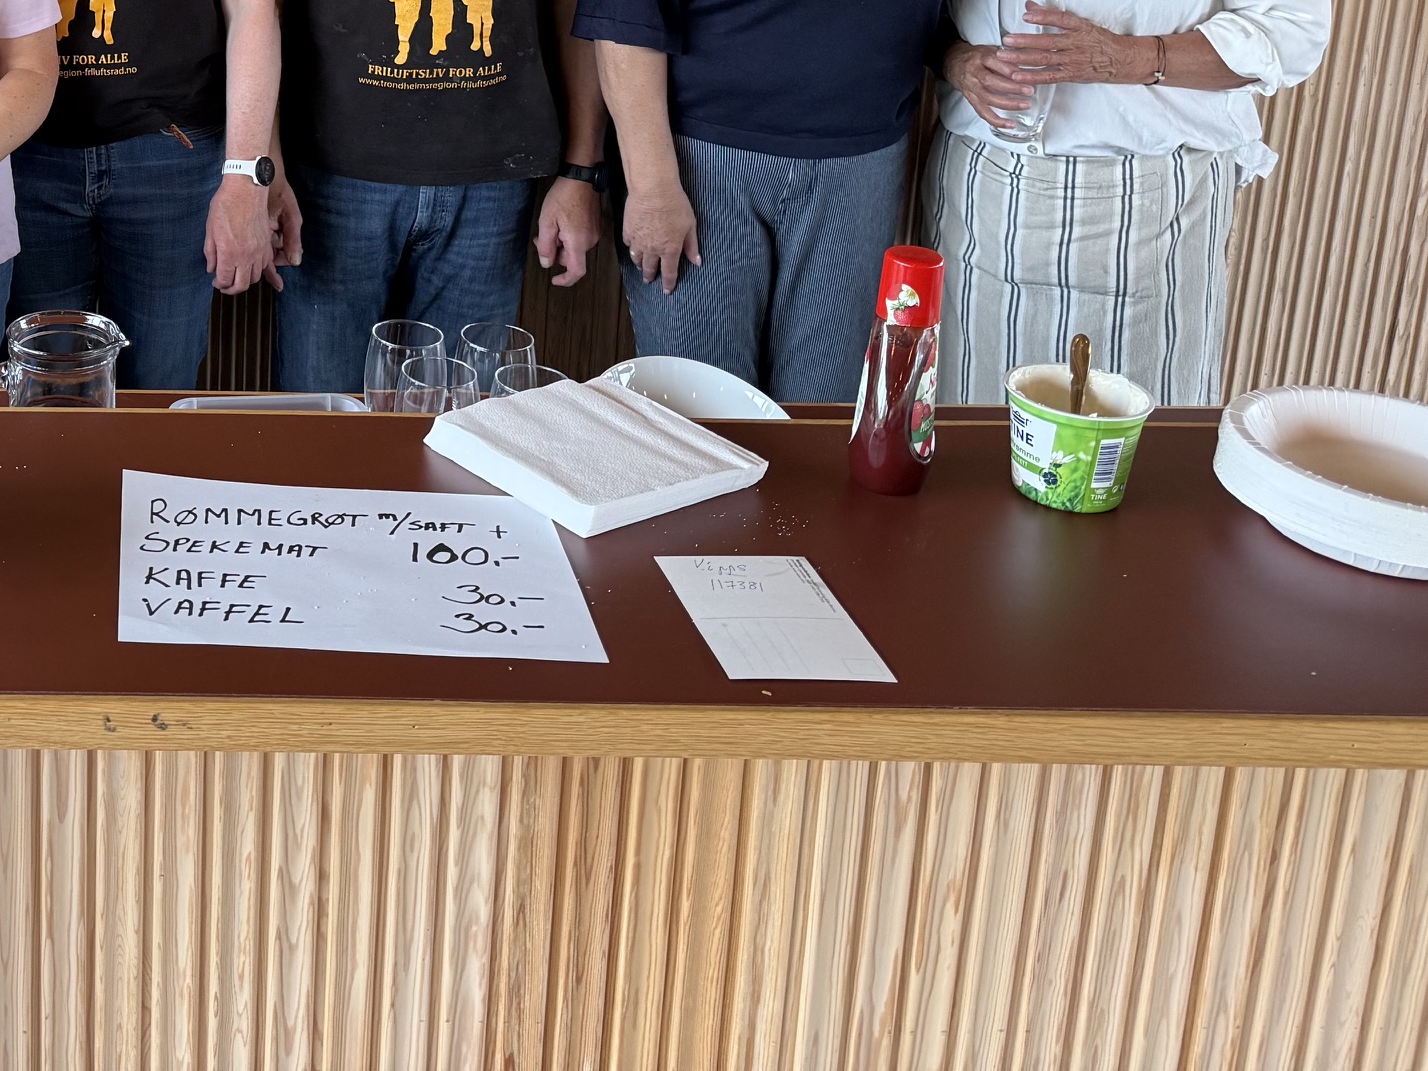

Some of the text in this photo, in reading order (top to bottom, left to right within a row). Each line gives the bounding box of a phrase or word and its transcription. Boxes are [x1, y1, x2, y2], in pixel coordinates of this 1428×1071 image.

[73, 55, 96, 65] FOR
[99, 53, 129, 64] ALLE
[59, 67, 137, 78] egion-friluftsrad.no
[368, 62, 503, 79] FRILUFTSLIV FOR ALLE
[1011, 419, 1034, 448] INE
[1090, 493, 1108, 501] TINE
[149, 498, 369, 529] RØMMEGRØT
[139, 531, 328, 558] SPEKEMAT
[144, 566, 267, 591] KAFFE
[711, 579, 764, 592] 117381
[141, 597, 305, 624] VAFFEL
